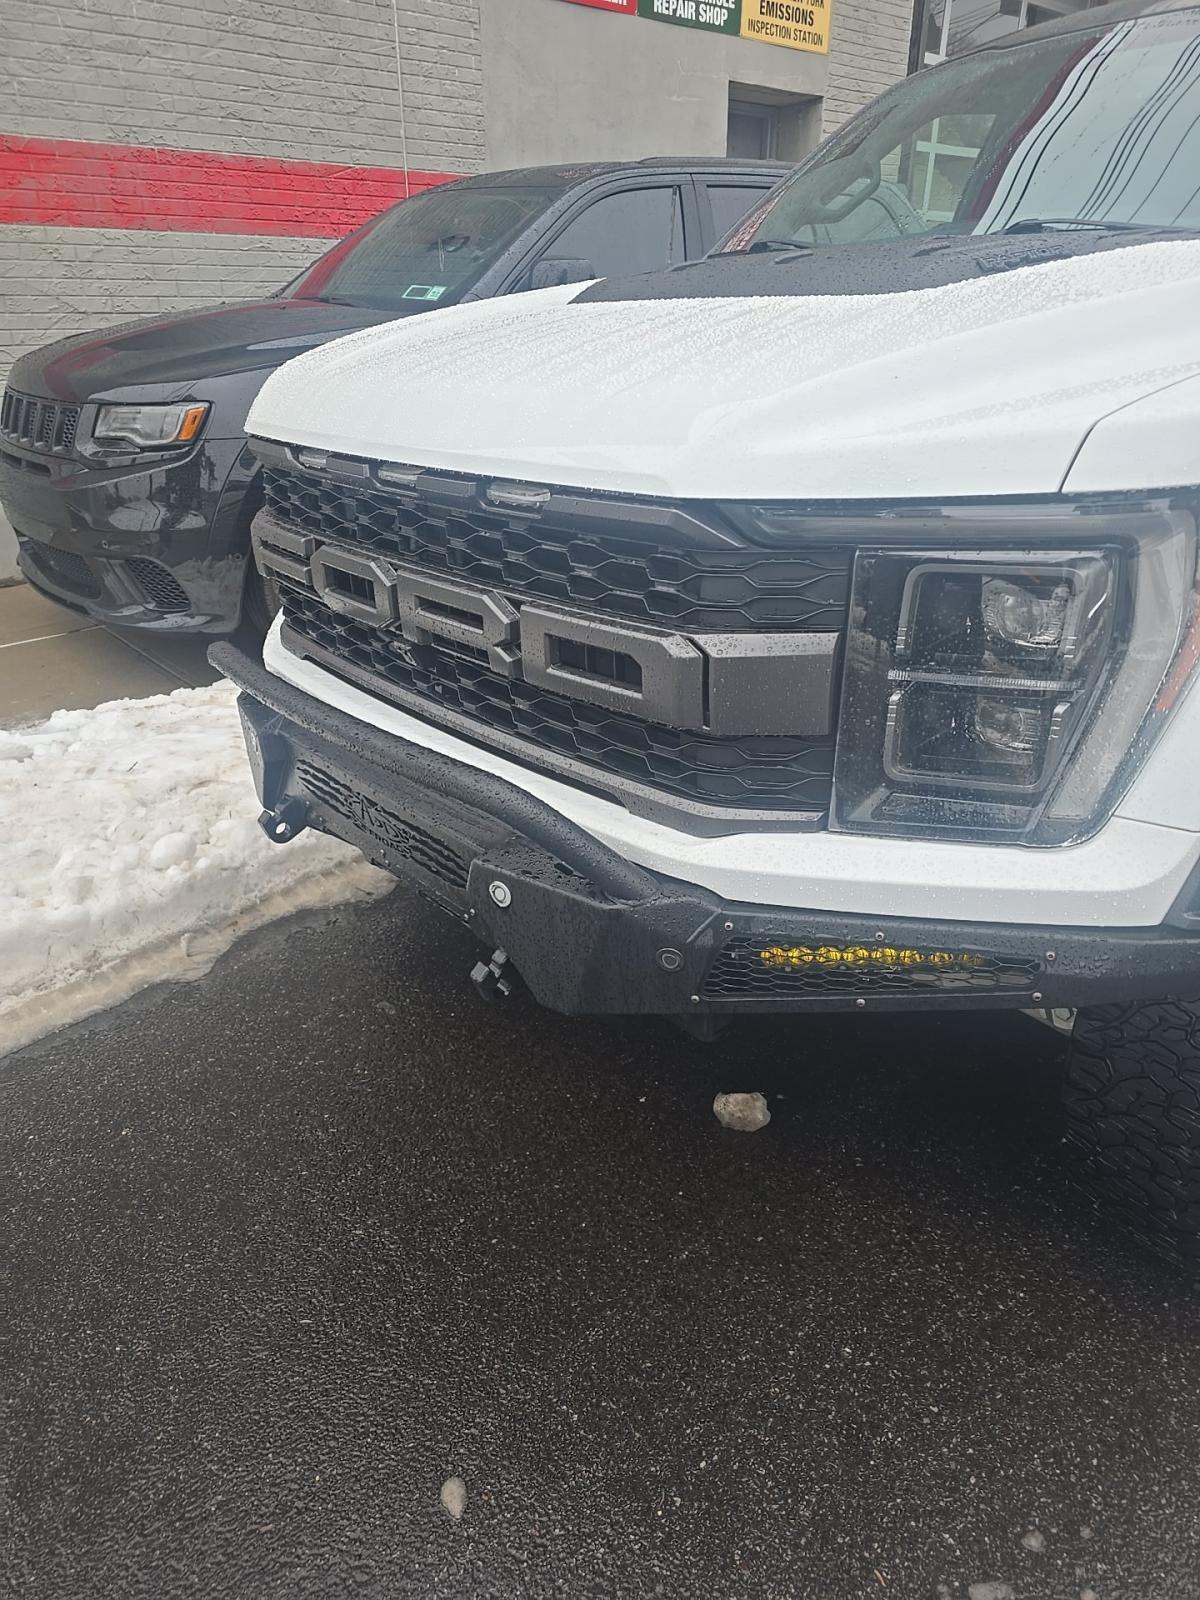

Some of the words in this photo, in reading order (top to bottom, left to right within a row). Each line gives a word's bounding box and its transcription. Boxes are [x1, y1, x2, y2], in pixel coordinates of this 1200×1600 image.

[653, 0, 696, 21] REPAIR
[698, 3, 728, 27] SHOP
[759, 0, 814, 27] EMISSIONS
[747, 17, 792, 40] INSPECTION
[793, 28, 824, 47] STATION
[250, 510, 704, 730] FORD
